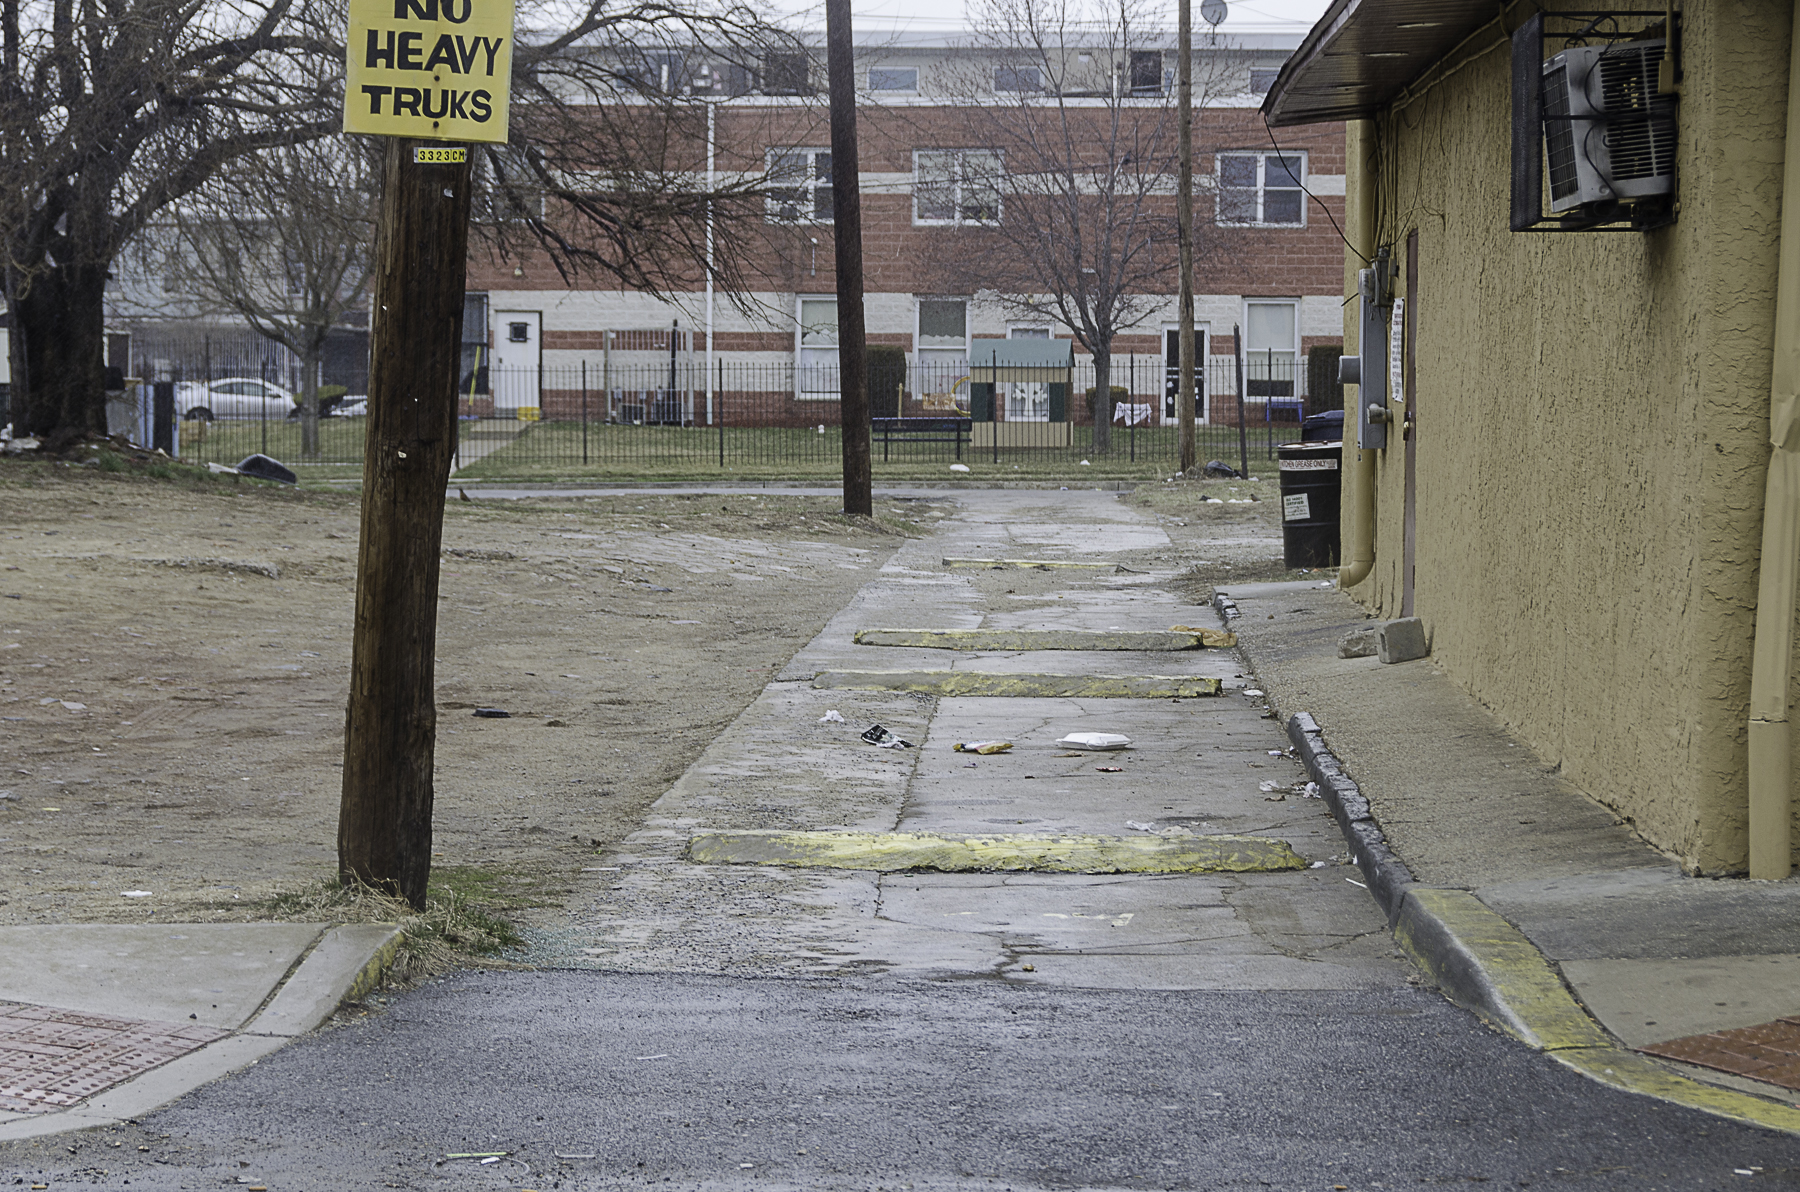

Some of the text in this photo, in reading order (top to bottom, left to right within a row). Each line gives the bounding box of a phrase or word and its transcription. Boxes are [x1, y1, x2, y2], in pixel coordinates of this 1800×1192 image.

[394, 0, 472, 24] NO
[365, 28, 504, 77] HEAVY
[361, 84, 493, 123] TRUKS
